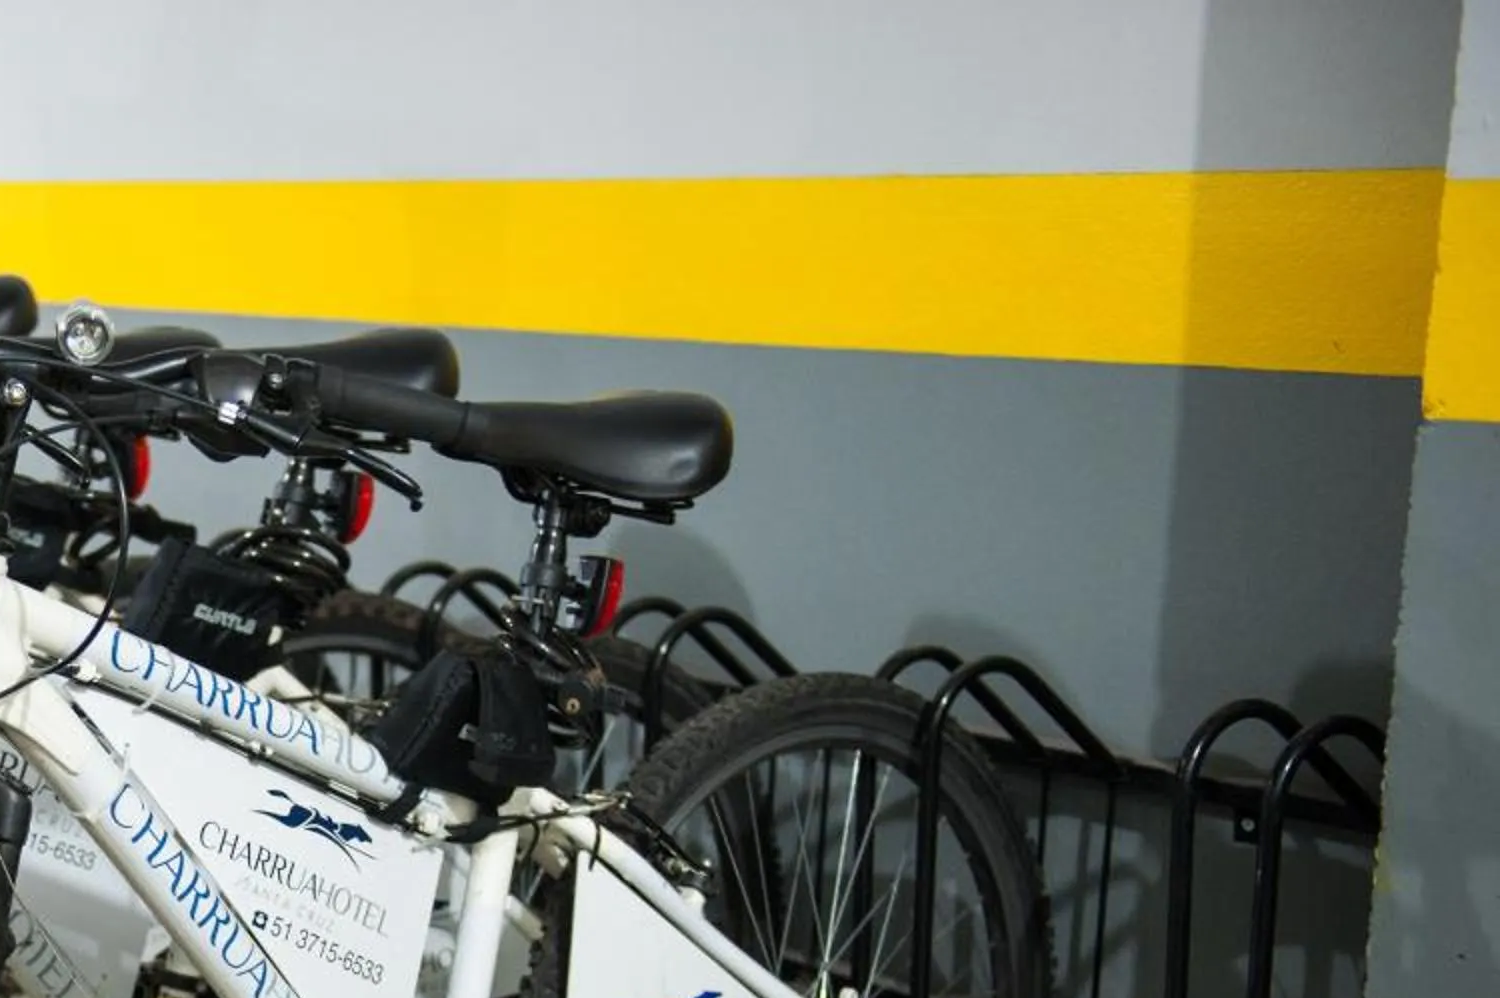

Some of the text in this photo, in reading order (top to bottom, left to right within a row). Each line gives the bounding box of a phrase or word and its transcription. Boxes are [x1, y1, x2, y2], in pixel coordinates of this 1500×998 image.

[111, 630, 380, 775] CHARRUAHO
[30, 833, 97, 871] 15-6533
[200, 821, 388, 938] CHARRUAHOTEL
[270, 916, 293, 941] 51
[295, 925, 386, 986] 3715-6533
